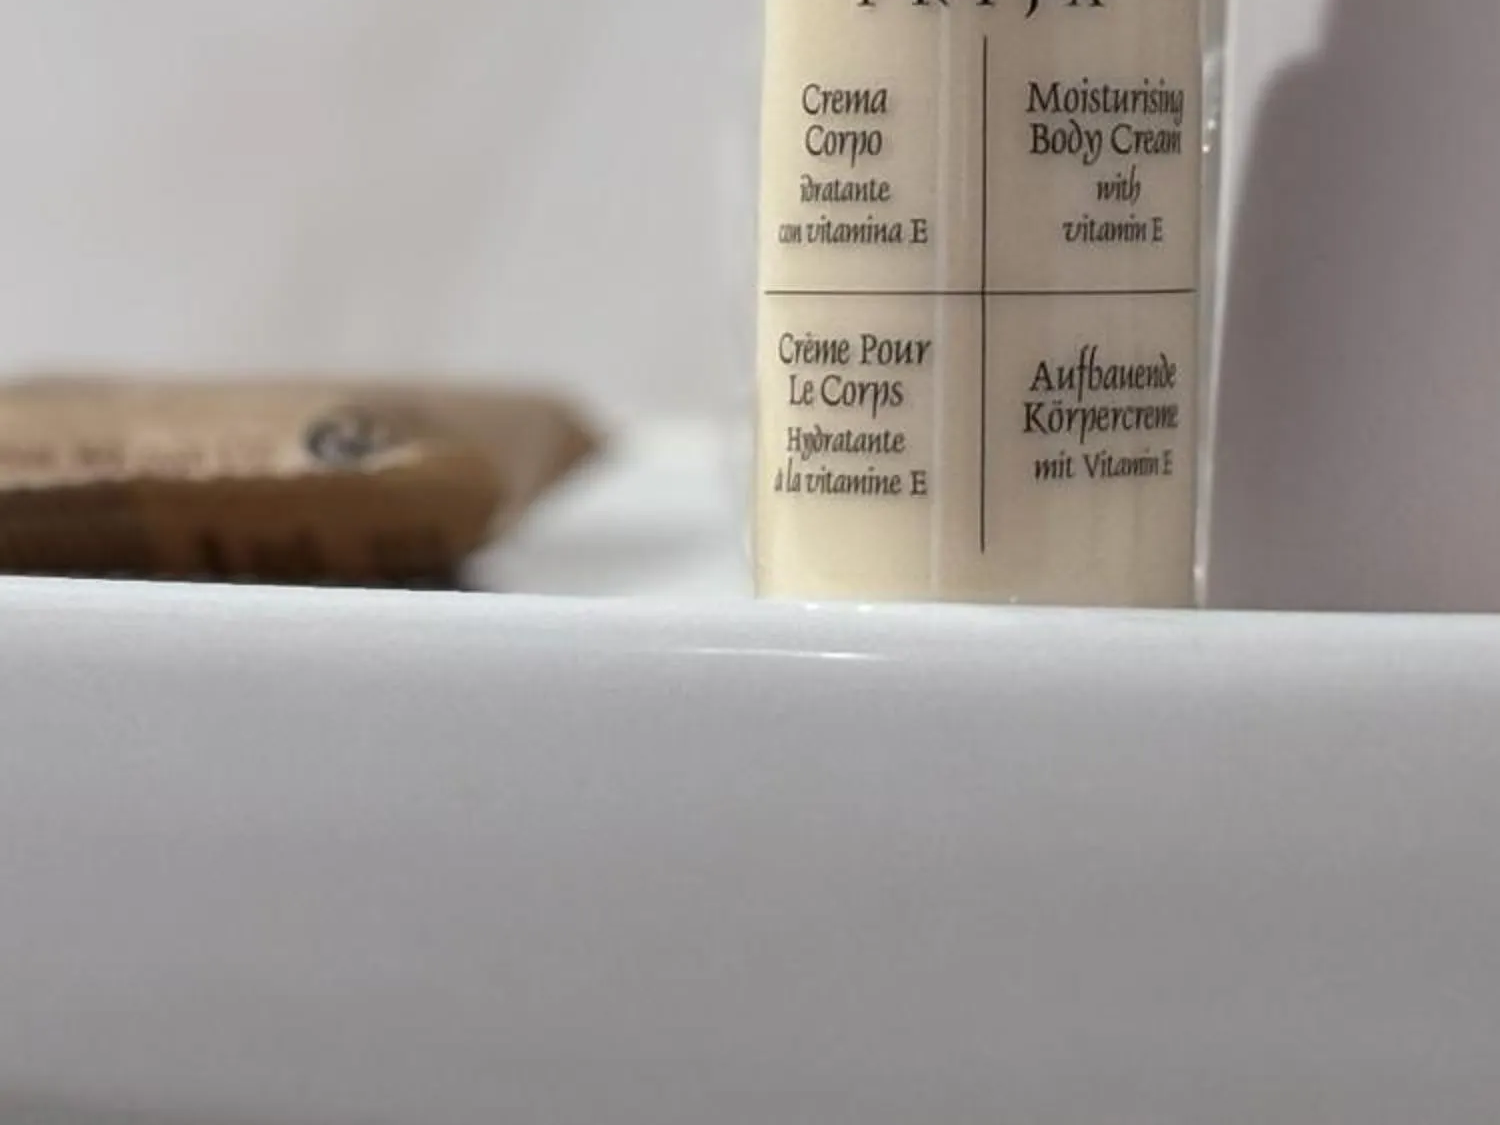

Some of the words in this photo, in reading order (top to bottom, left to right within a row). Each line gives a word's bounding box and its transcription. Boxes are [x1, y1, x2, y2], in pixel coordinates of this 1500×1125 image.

[801, 82, 888, 115] Crema
[1026, 77, 1185, 123] Moisturising
[805, 124, 883, 167] Corpo
[1030, 119, 1102, 165] Body
[1111, 123, 1181, 155] Cream
[1096, 164, 1141, 205] with
[806, 214, 903, 245] vitamina
[908, 218, 929, 244] E
[1063, 213, 1147, 244] vitamin
[1151, 216, 1165, 243] E
[860, 334, 932, 367] Pour
[1029, 343, 1178, 403] Aufbauende
[789, 375, 814, 406] Le
[820, 375, 904, 418] Corps
[1023, 401, 1179, 444] Körpercreme
[786, 426, 906, 461] Hydratante
[786, 457, 801, 493] la
[806, 465, 903, 496] vitamine
[909, 469, 929, 496] E
[1034, 450, 1075, 483] mit
[1083, 448, 1160, 480] Vitamin
[1163, 448, 1174, 476] E
